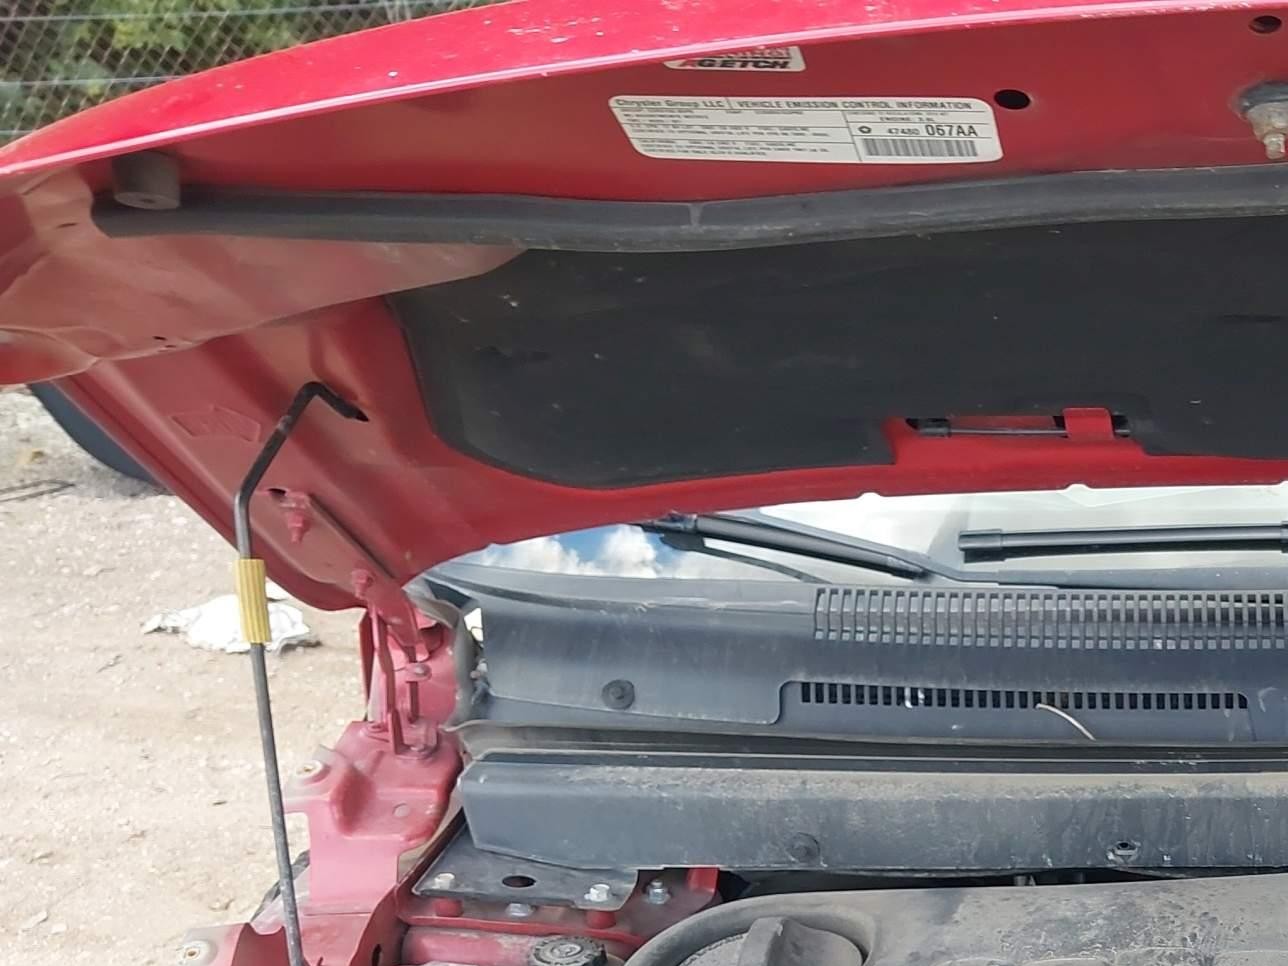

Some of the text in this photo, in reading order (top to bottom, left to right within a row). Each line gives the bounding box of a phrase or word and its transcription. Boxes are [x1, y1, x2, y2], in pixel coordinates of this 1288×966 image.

[702, 100, 726, 108] LLC
[737, 101, 782, 109] VEHICLE
[785, 101, 839, 109] EMISSION
[841, 101, 893, 109] CONTROL
[896, 101, 973, 110] INFORMATION
[924, 124, 978, 137] 067AA
